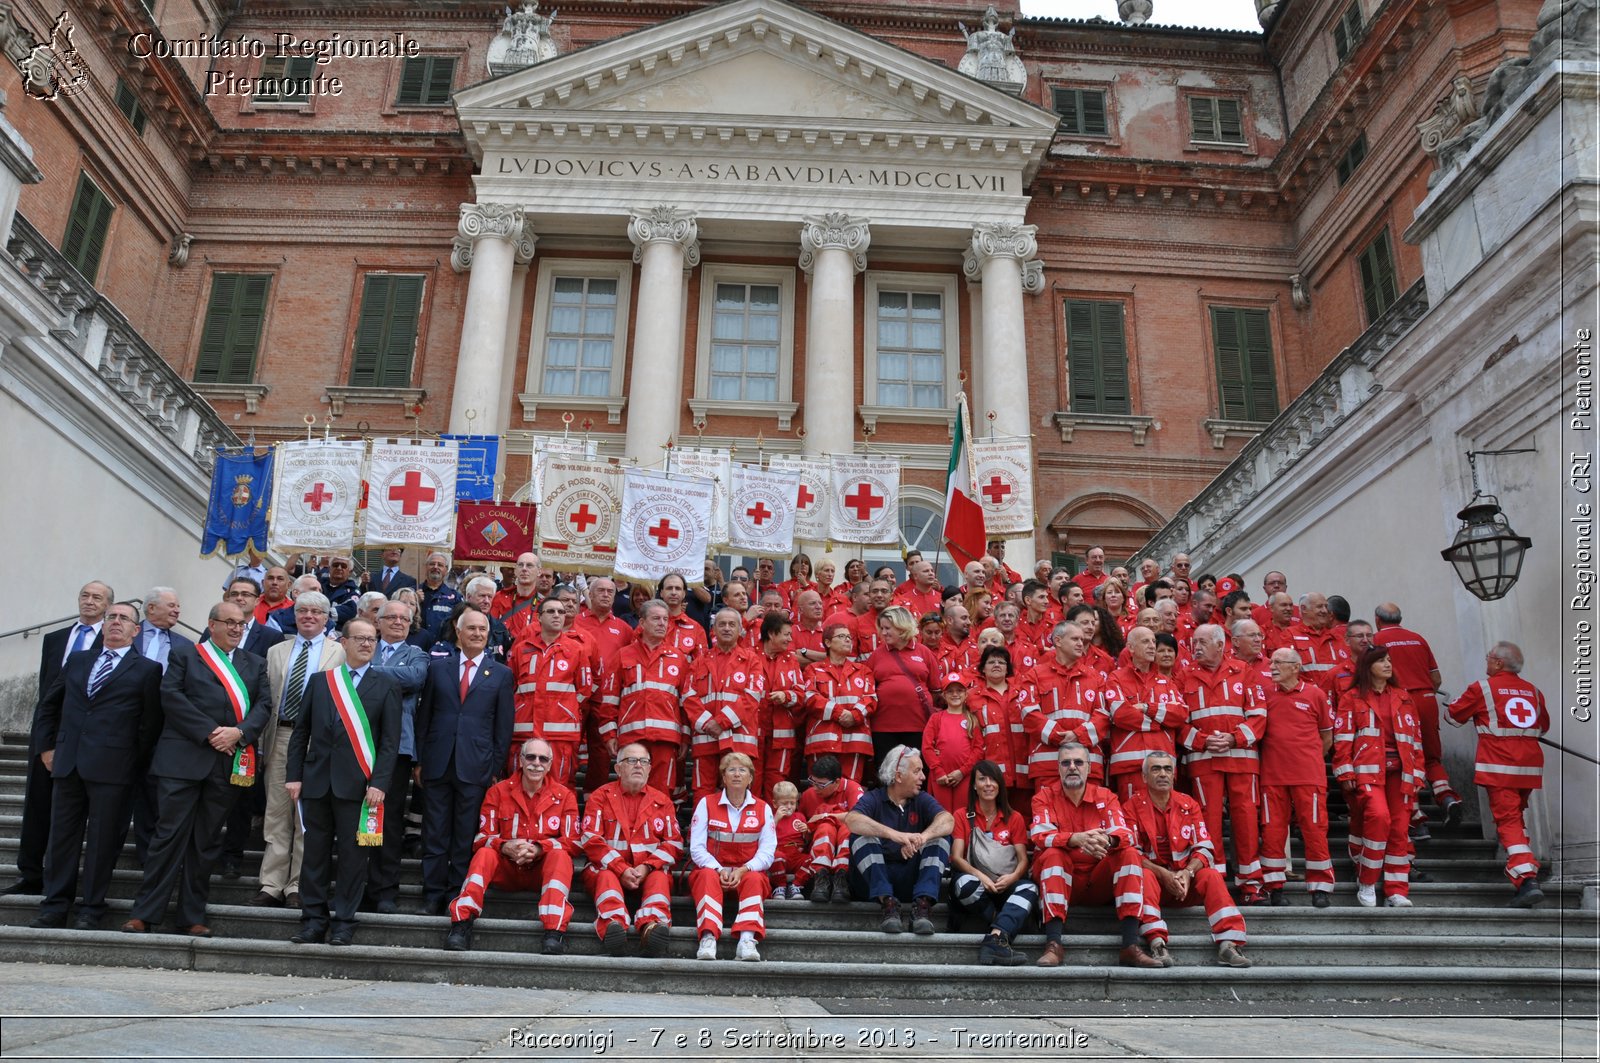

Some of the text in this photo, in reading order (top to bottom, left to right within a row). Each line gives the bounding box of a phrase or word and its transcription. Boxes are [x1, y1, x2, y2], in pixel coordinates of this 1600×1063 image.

[499, 157, 662, 177] LVDOVICVS
[707, 163, 855, 186] SABAVDIA
[868, 169, 1005, 192] MDCCLVII
[373, 455, 398, 463] CROCE
[568, 464, 592, 472] VOLONTARI
[544, 477, 623, 515] CROCE ROSSA ITALIANA
[576, 491, 602, 504] GINEVRA
[625, 493, 706, 532] CROCE ROSSA ITALIANA
[655, 505, 684, 519] GINEVRA
[488, 510, 527, 532] COMUNAL
[380, 524, 430, 532] DELEGAZIONE
[381, 532, 436, 540] PEVERAGNO
[470, 549, 514, 558] RACCONIGI
[541, 549, 576, 558] COMITATO
[584, 552, 616, 561] MONDOV
[621, 562, 649, 571] GRUPPO
